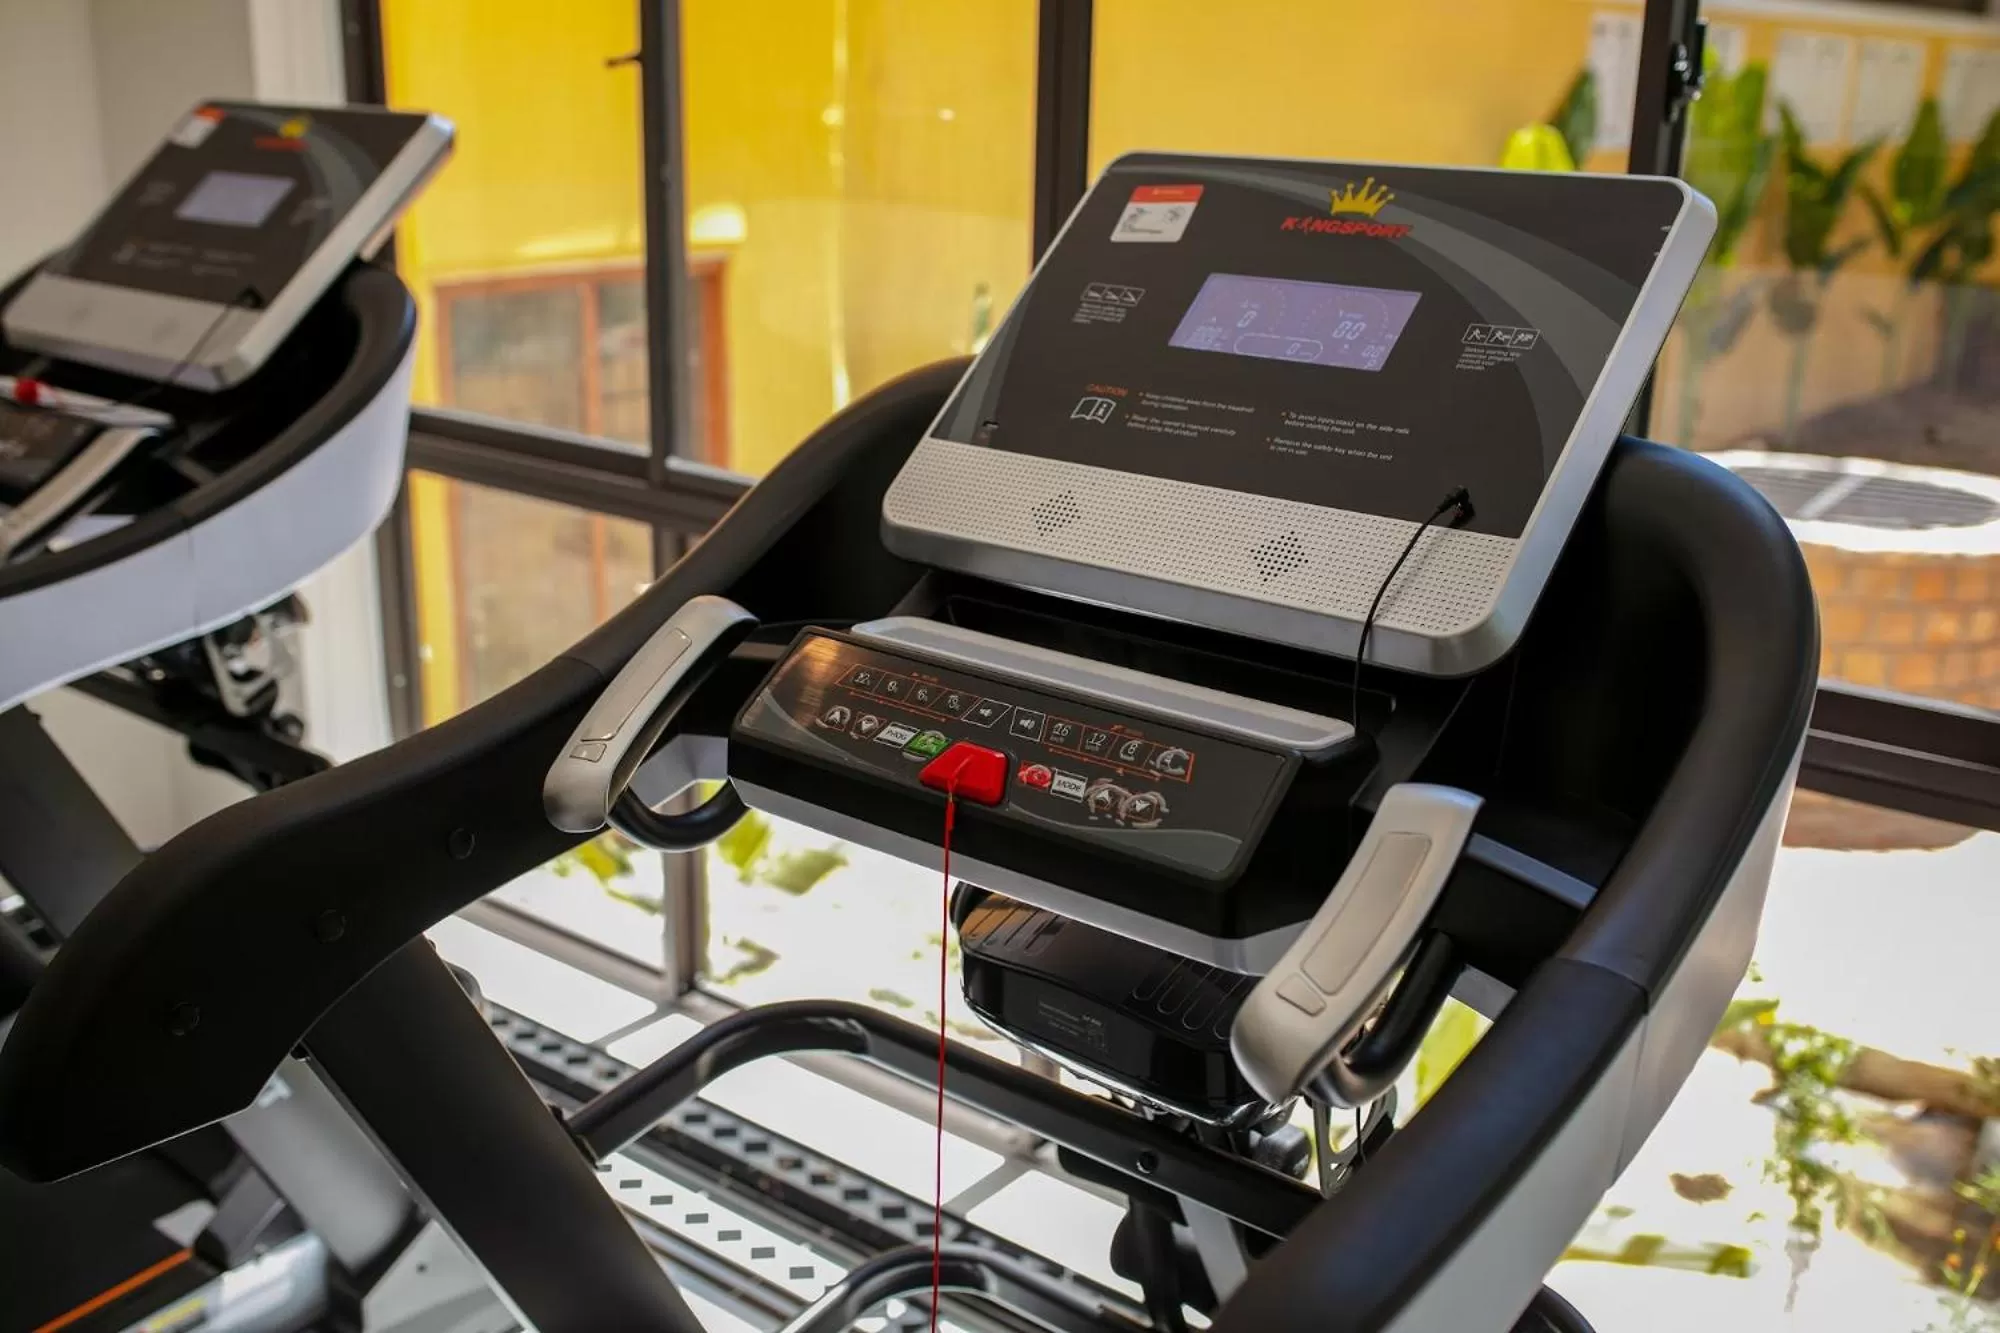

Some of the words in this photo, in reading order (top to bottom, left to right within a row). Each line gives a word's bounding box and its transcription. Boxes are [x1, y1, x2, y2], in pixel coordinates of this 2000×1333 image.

[1280, 217, 1413, 238] KINGSPORT
[1085, 383, 1128, 397] CAUTION
[1056, 778, 1083, 792] MODE
